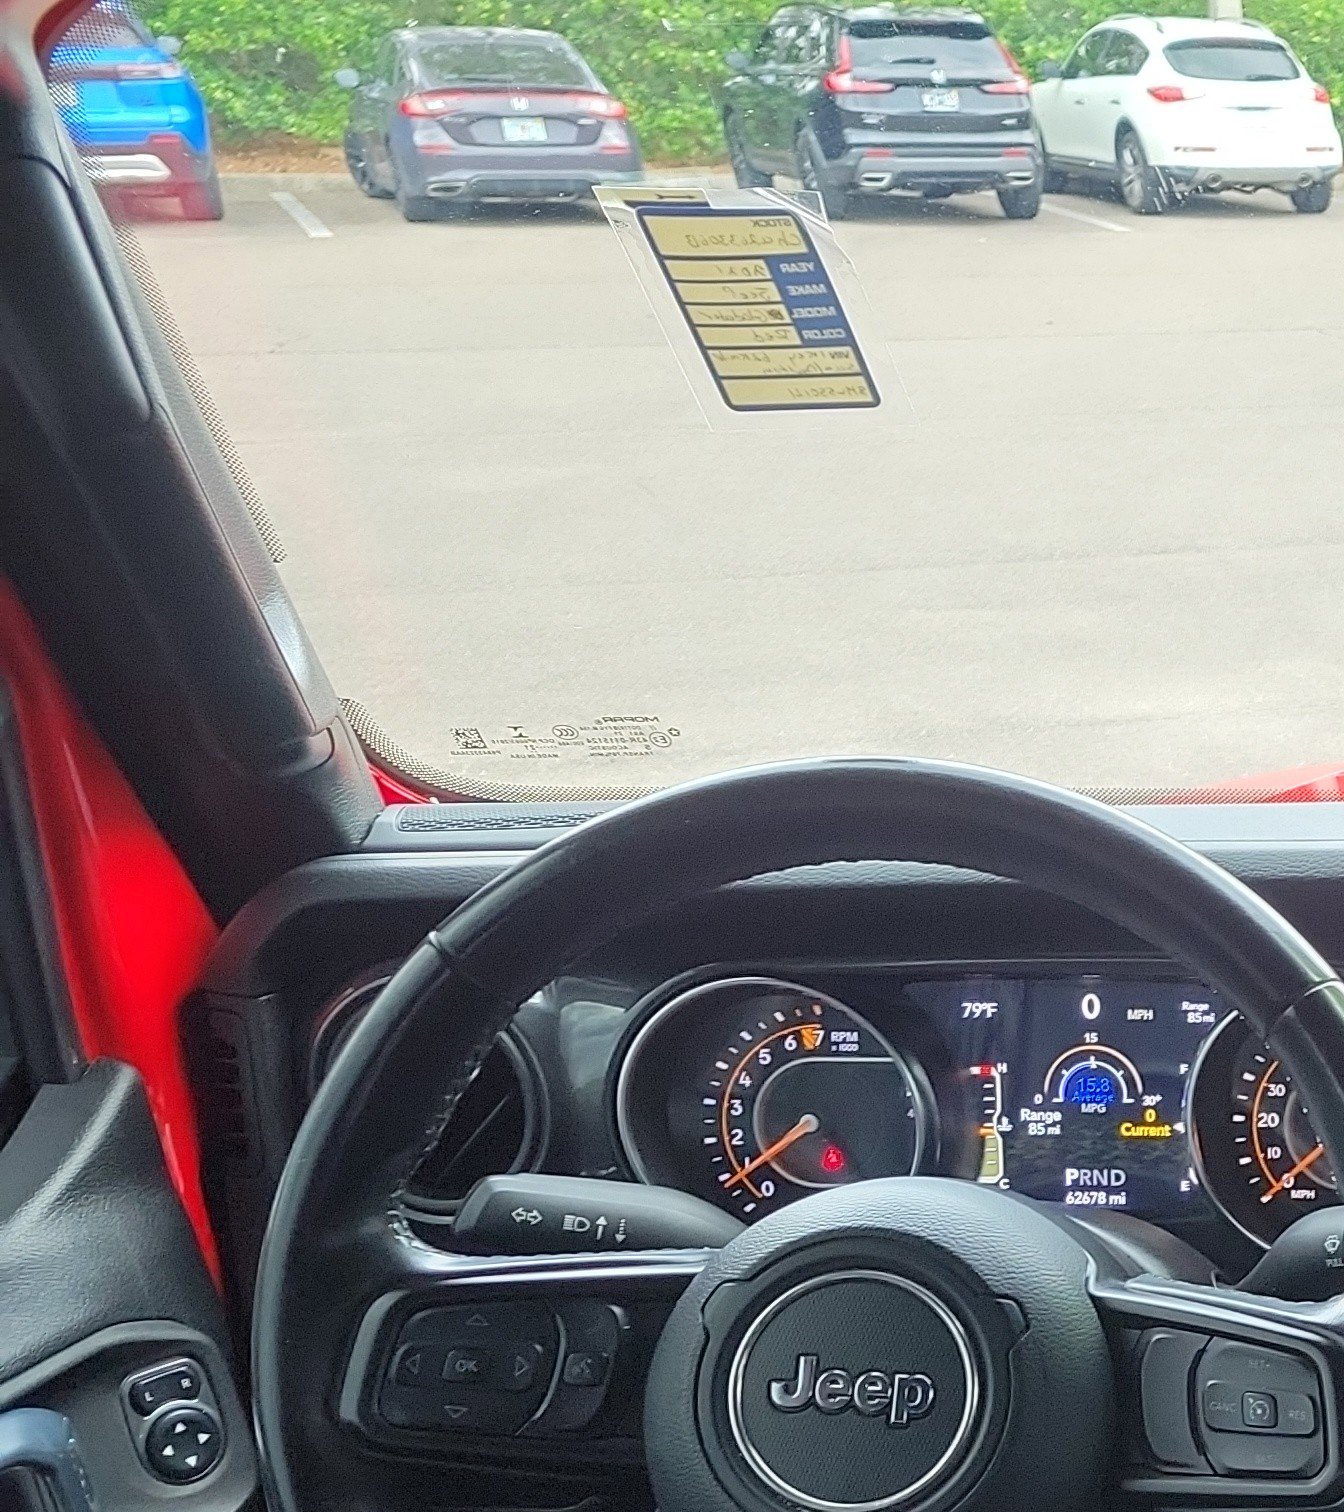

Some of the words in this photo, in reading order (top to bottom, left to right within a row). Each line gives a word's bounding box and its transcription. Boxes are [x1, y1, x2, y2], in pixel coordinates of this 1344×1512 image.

[961, 1001, 999, 1019] 79°F
[1081, 992, 1101, 1020] 0
[1127, 1008, 1154, 1021] MPH
[1181, 1000, 1211, 1013] Range
[1186, 1012, 1202, 1024] 85
[783, 1034, 798, 1051] 6
[811, 1029, 826, 1047] 7
[830, 1031, 860, 1043] RPM
[1083, 1032, 1099, 1043] 15
[758, 1049, 772, 1066] 5
[997, 1062, 1008, 1074] H
[1179, 1063, 1189, 1075] F
[738, 1071, 752, 1088] 4
[1266, 1083, 1287, 1098] 30
[1034, 1093, 1044, 1105] 0
[729, 1099, 743, 1116] 3
[1081, 1103, 1107, 1114] MPG
[1020, 1108, 1062, 1124] Range
[1144, 1108, 1157, 1122] 0
[1257, 1112, 1280, 1129] 20
[1028, 1123, 1046, 1136] 85
[1047, 1124, 1061, 1136] mi
[1120, 1123, 1172, 1138] Current
[730, 1129, 744, 1146] 2
[1266, 1146, 1282, 1160] 10
[760, 1180, 775, 1197] 0
[998, 1178, 1011, 1190] C
[1180, 1180, 1191, 1192] E
[1065, 1191, 1107, 1206] 62678
[1108, 1191, 1127, 1206] mi
[1290, 1189, 1316, 1200] MPH
[180, 1377, 192, 1389] R
[765, 1353, 935, 1428] Jeep
